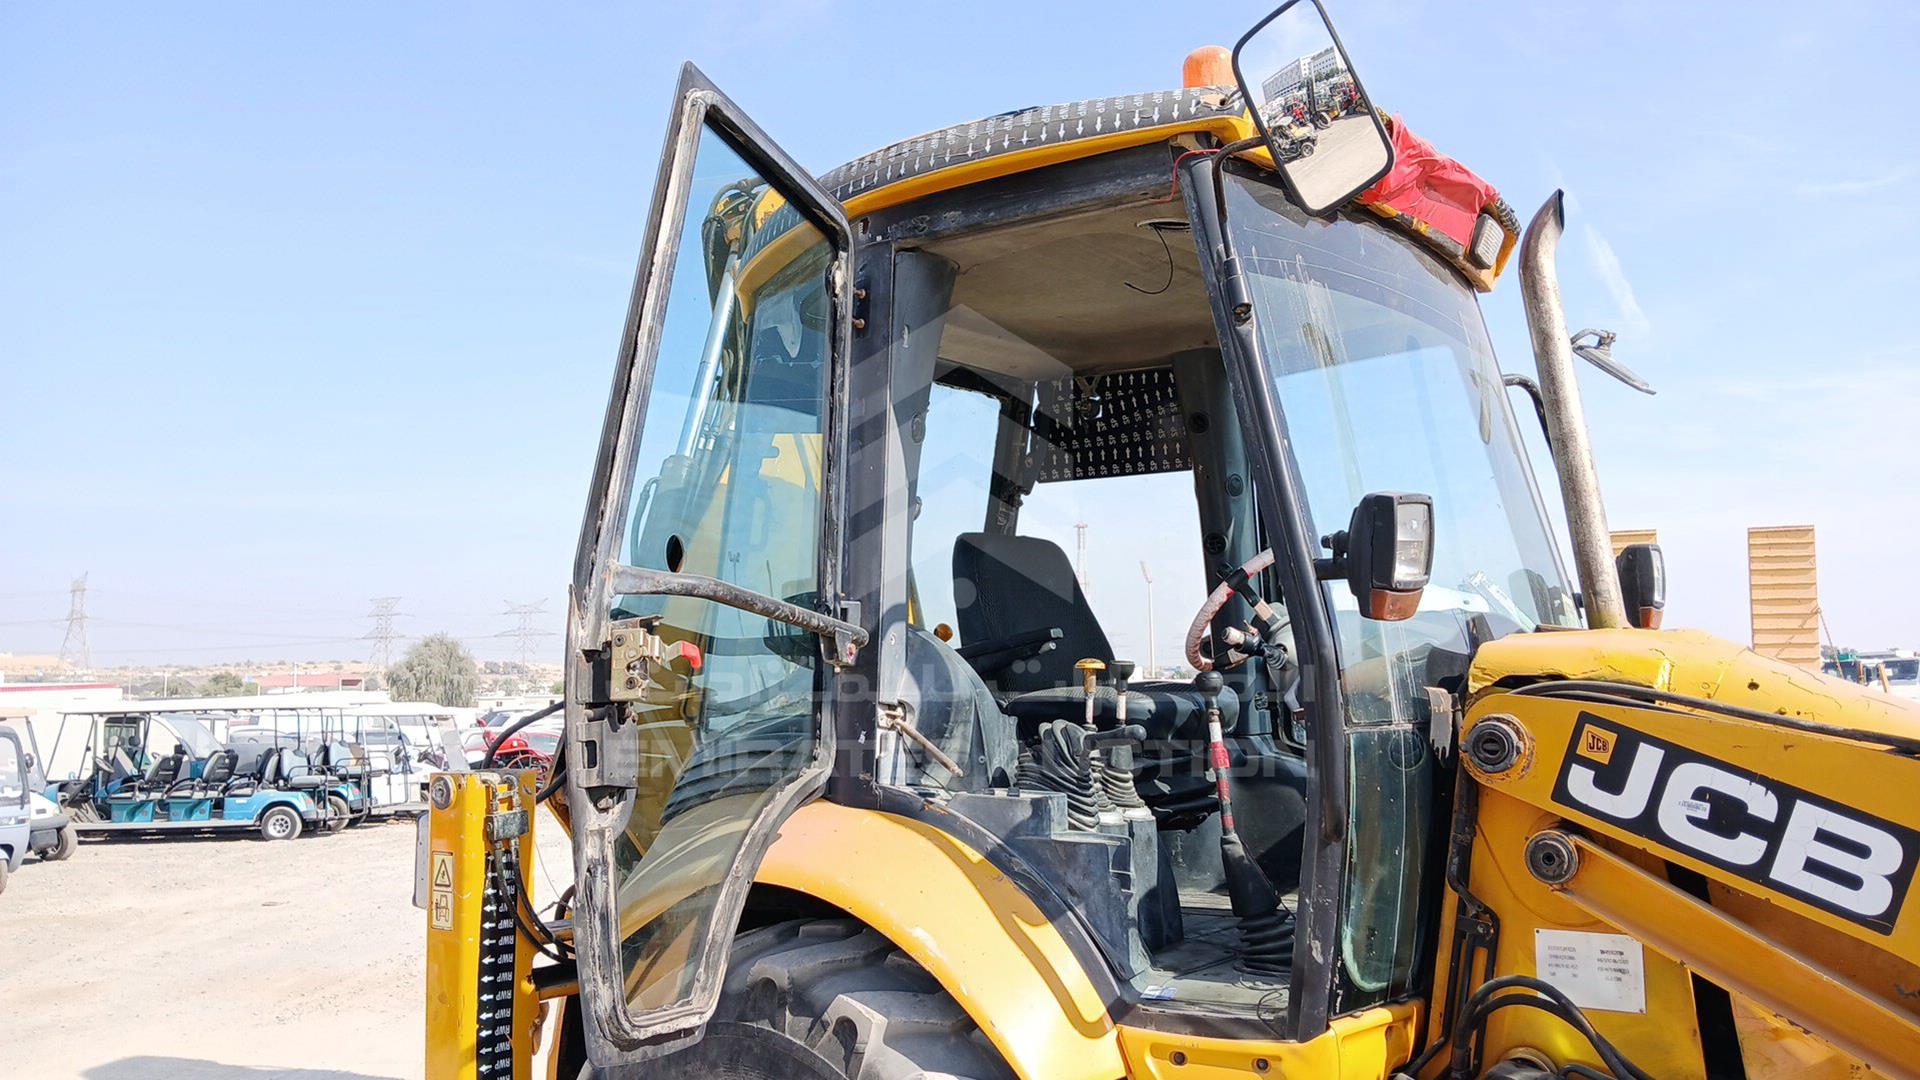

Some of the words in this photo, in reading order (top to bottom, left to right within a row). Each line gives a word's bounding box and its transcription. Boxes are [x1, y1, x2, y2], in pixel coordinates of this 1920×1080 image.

[1588, 733, 1608, 752] JCB
[1567, 742, 1903, 916] JCB
[498, 918, 514, 930] RWP
[498, 935, 514, 946] RWP
[498, 954, 514, 964] RWP
[496, 971, 512, 982] RWP
[496, 990, 512, 1000] RWP
[494, 1008, 511, 1020] RWP
[494, 1024, 510, 1036] RWP
[494, 1041, 510, 1053] RWP
[494, 1058, 510, 1070] RWP
